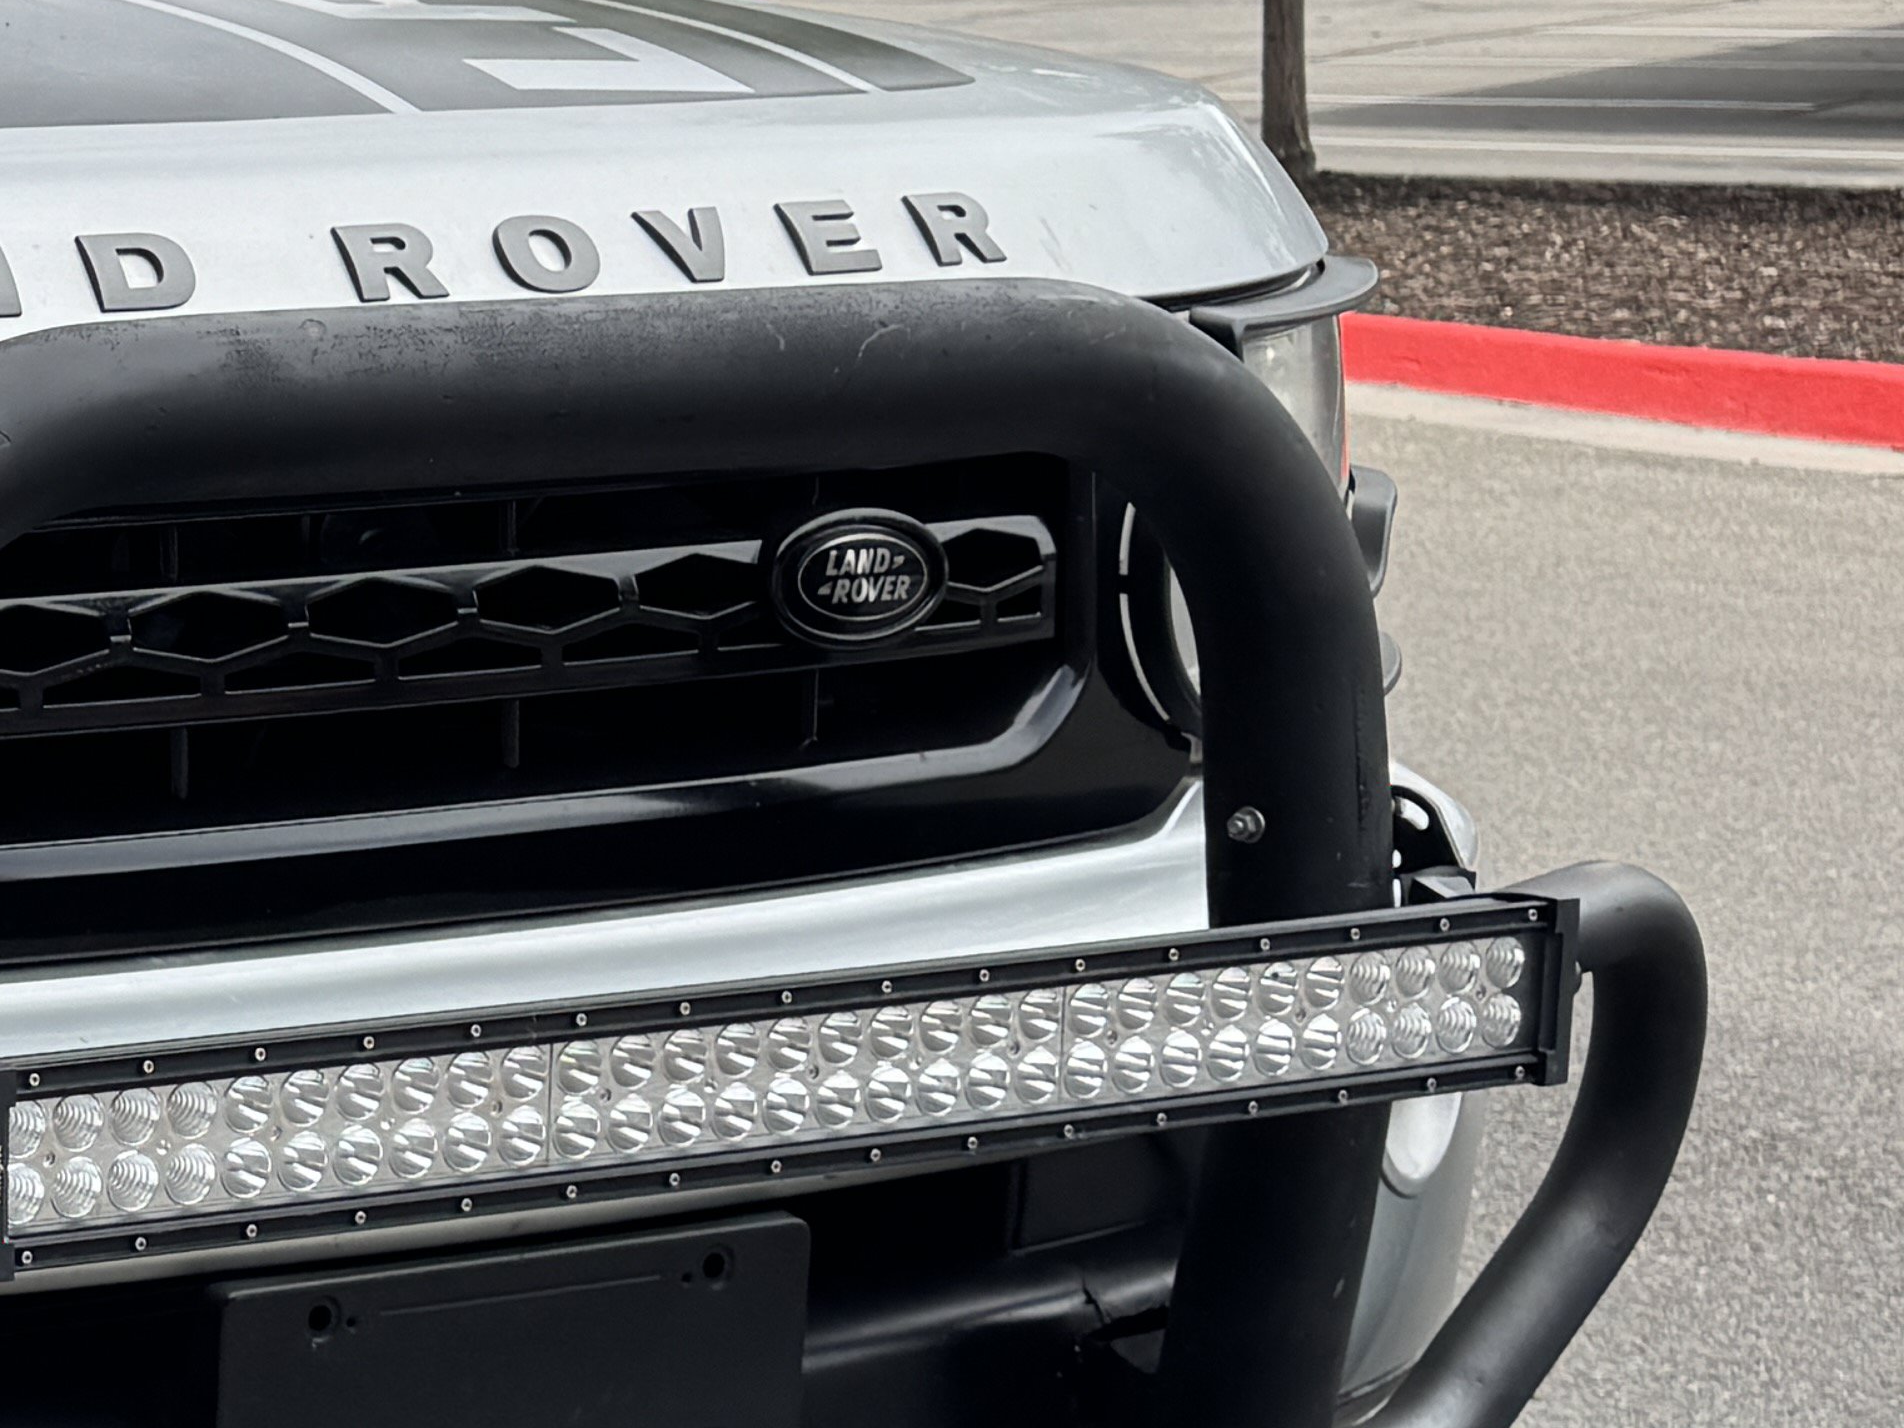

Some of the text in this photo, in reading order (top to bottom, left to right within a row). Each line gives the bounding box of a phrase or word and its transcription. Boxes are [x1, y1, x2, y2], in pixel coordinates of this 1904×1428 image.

[330, 189, 1010, 303] ROVER
[826, 548, 891, 576] LAND
[833, 576, 911, 604] ROVER
